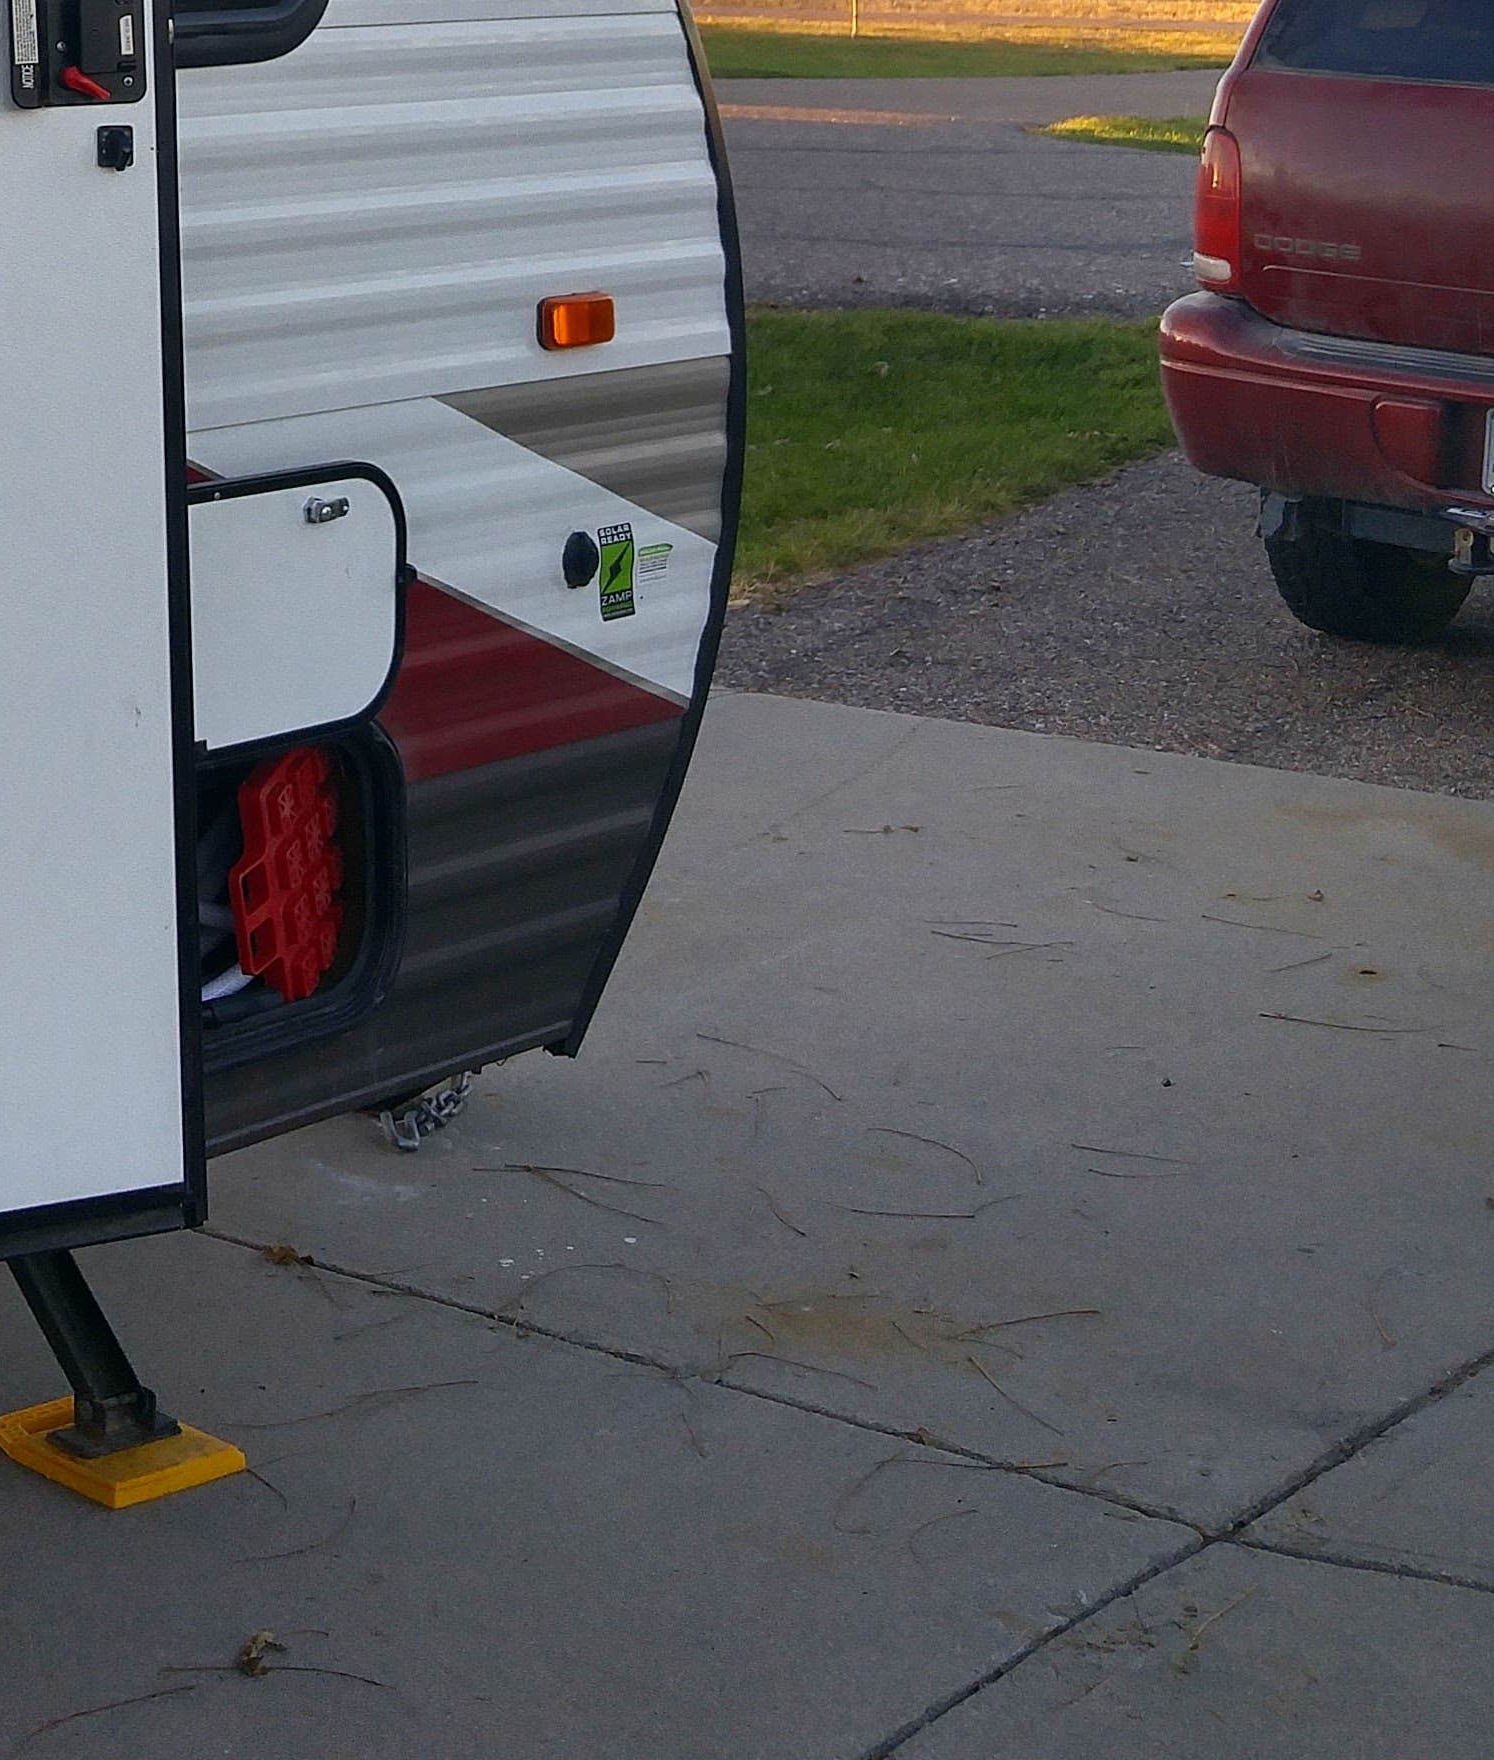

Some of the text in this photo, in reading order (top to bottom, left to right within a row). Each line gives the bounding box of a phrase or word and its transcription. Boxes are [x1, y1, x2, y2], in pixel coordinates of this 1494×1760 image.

[1254, 233, 1362, 260] DODGE
[599, 524, 630, 537] SOLAR
[600, 532, 631, 545] READY
[601, 590, 632, 606] ZAMP
